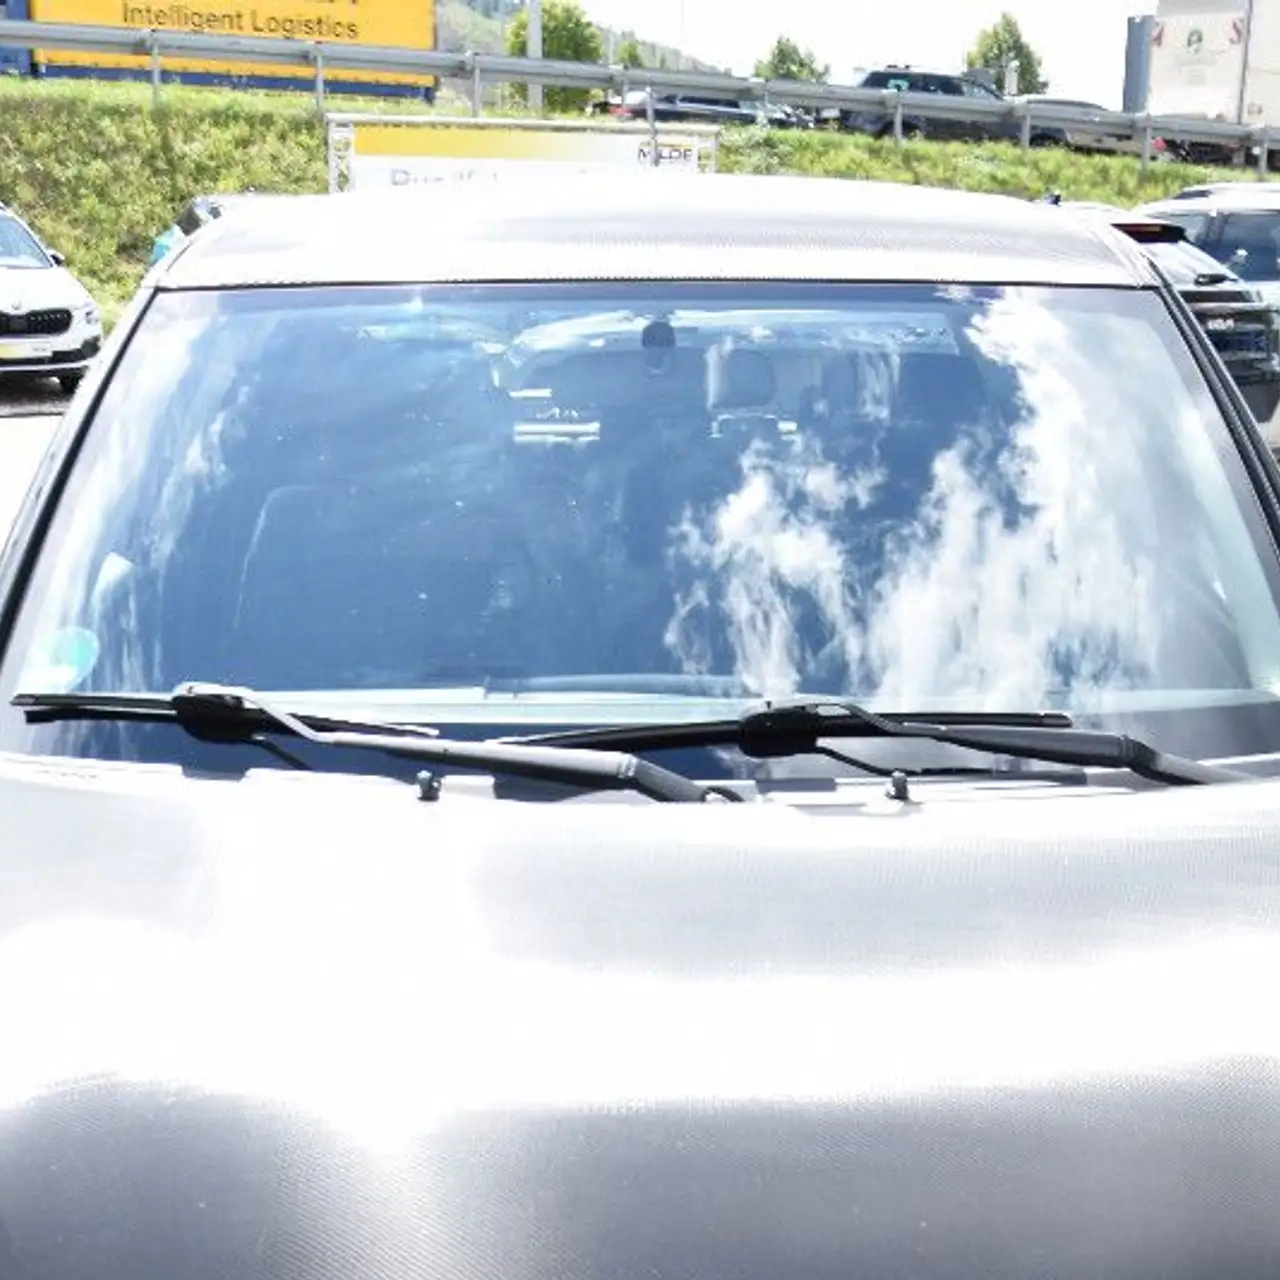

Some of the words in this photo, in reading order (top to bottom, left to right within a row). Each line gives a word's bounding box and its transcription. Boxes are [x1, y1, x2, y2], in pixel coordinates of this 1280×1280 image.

[122, 2, 244, 34] Intelligent
[251, 10, 360, 40] Logistics
[637, 147, 693, 163] MLDE
